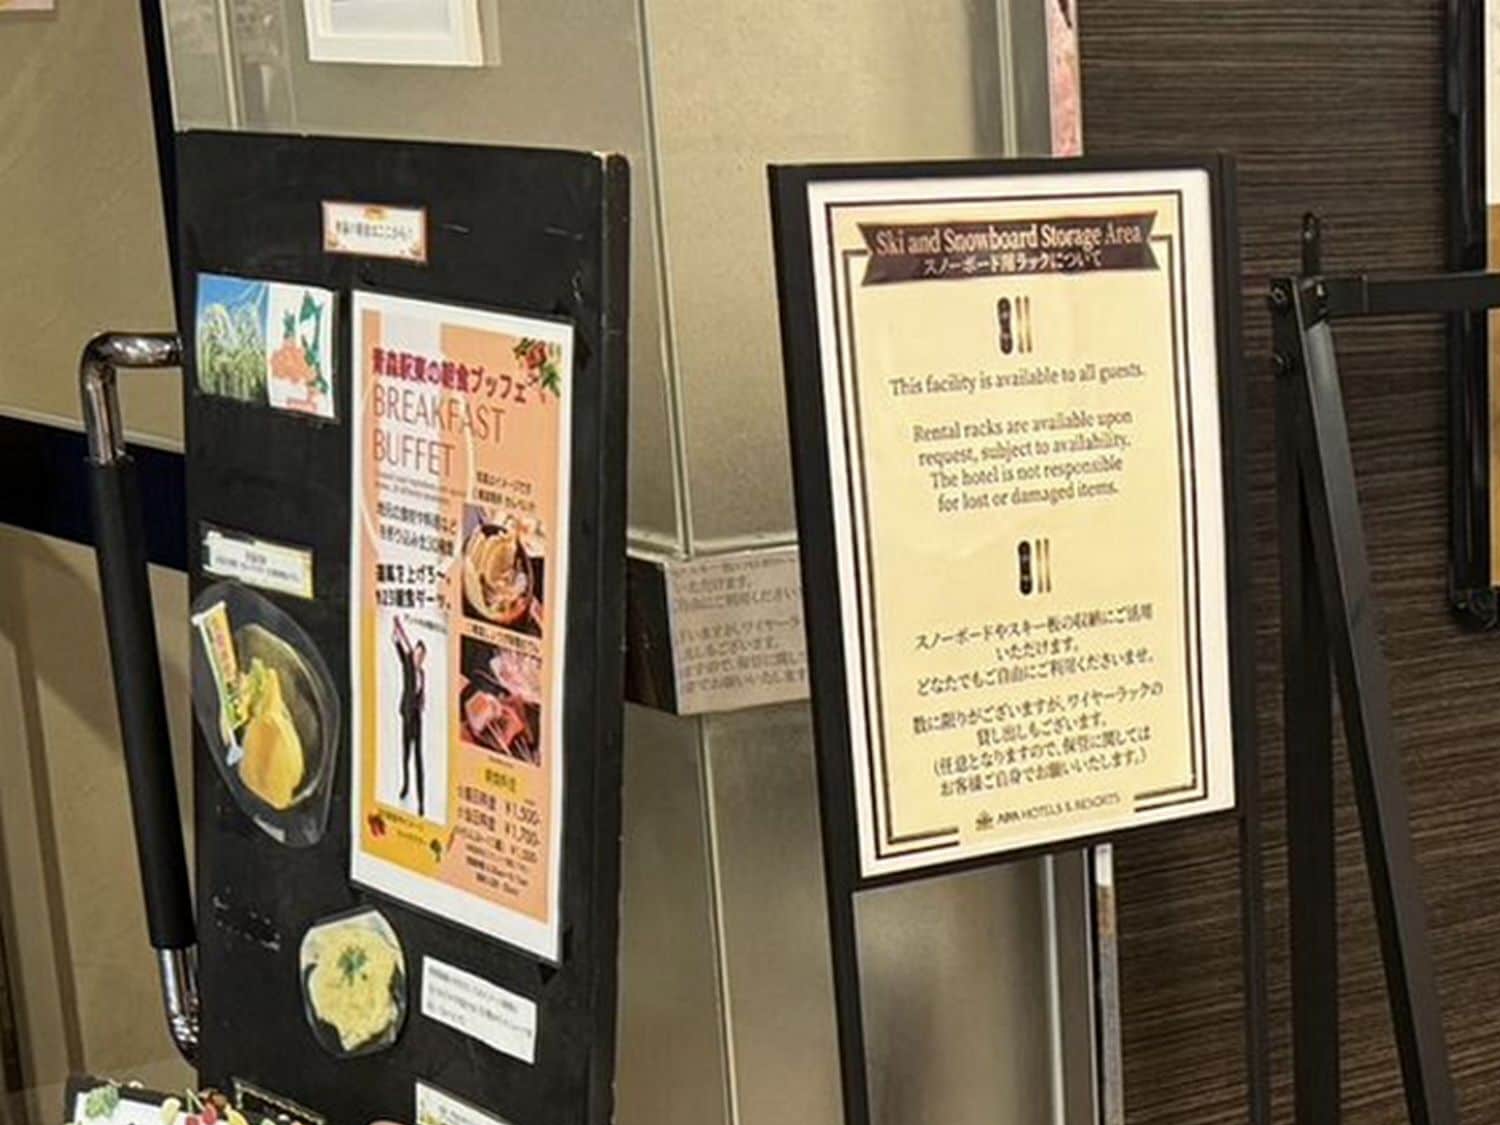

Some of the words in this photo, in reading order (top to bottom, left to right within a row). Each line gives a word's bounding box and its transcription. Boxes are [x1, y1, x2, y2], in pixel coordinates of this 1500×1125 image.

[876, 230, 903, 255] Ski
[909, 229, 940, 253] and
[943, 223, 1037, 253] Snowboard
[1040, 221, 1102, 250] Storage
[1105, 221, 1143, 246] Area
[890, 377, 922, 397] This
[926, 371, 976, 396] facility
[981, 372, 993, 389] is
[995, 366, 1060, 388] available
[1061, 367, 1076, 384] to
[1080, 363, 1096, 381] all
[373, 382, 506, 443] BREAKFAST
[913, 421, 961, 443] Rental
[964, 417, 1001, 439] racks
[1007, 418, 1030, 435] are
[1032, 409, 1094, 433] available
[1096, 409, 1133, 429] upon
[373, 427, 455, 478] BUFFET
[981, 441, 1032, 464] subject
[1035, 440, 1050, 456] to
[930, 470, 958, 489] The
[962, 465, 999, 486] hotel
[1002, 466, 1014, 482] is
[1017, 462, 1041, 481] not
[1044, 453, 1124, 480] responsible
[938, 491, 959, 513] for
[963, 490, 989, 510] lost
[992, 490, 1008, 507] or
[1011, 480, 1074, 506] damaged
[1077, 478, 1119, 498] items.
[996, 635, 1080, 662] いただけます。
